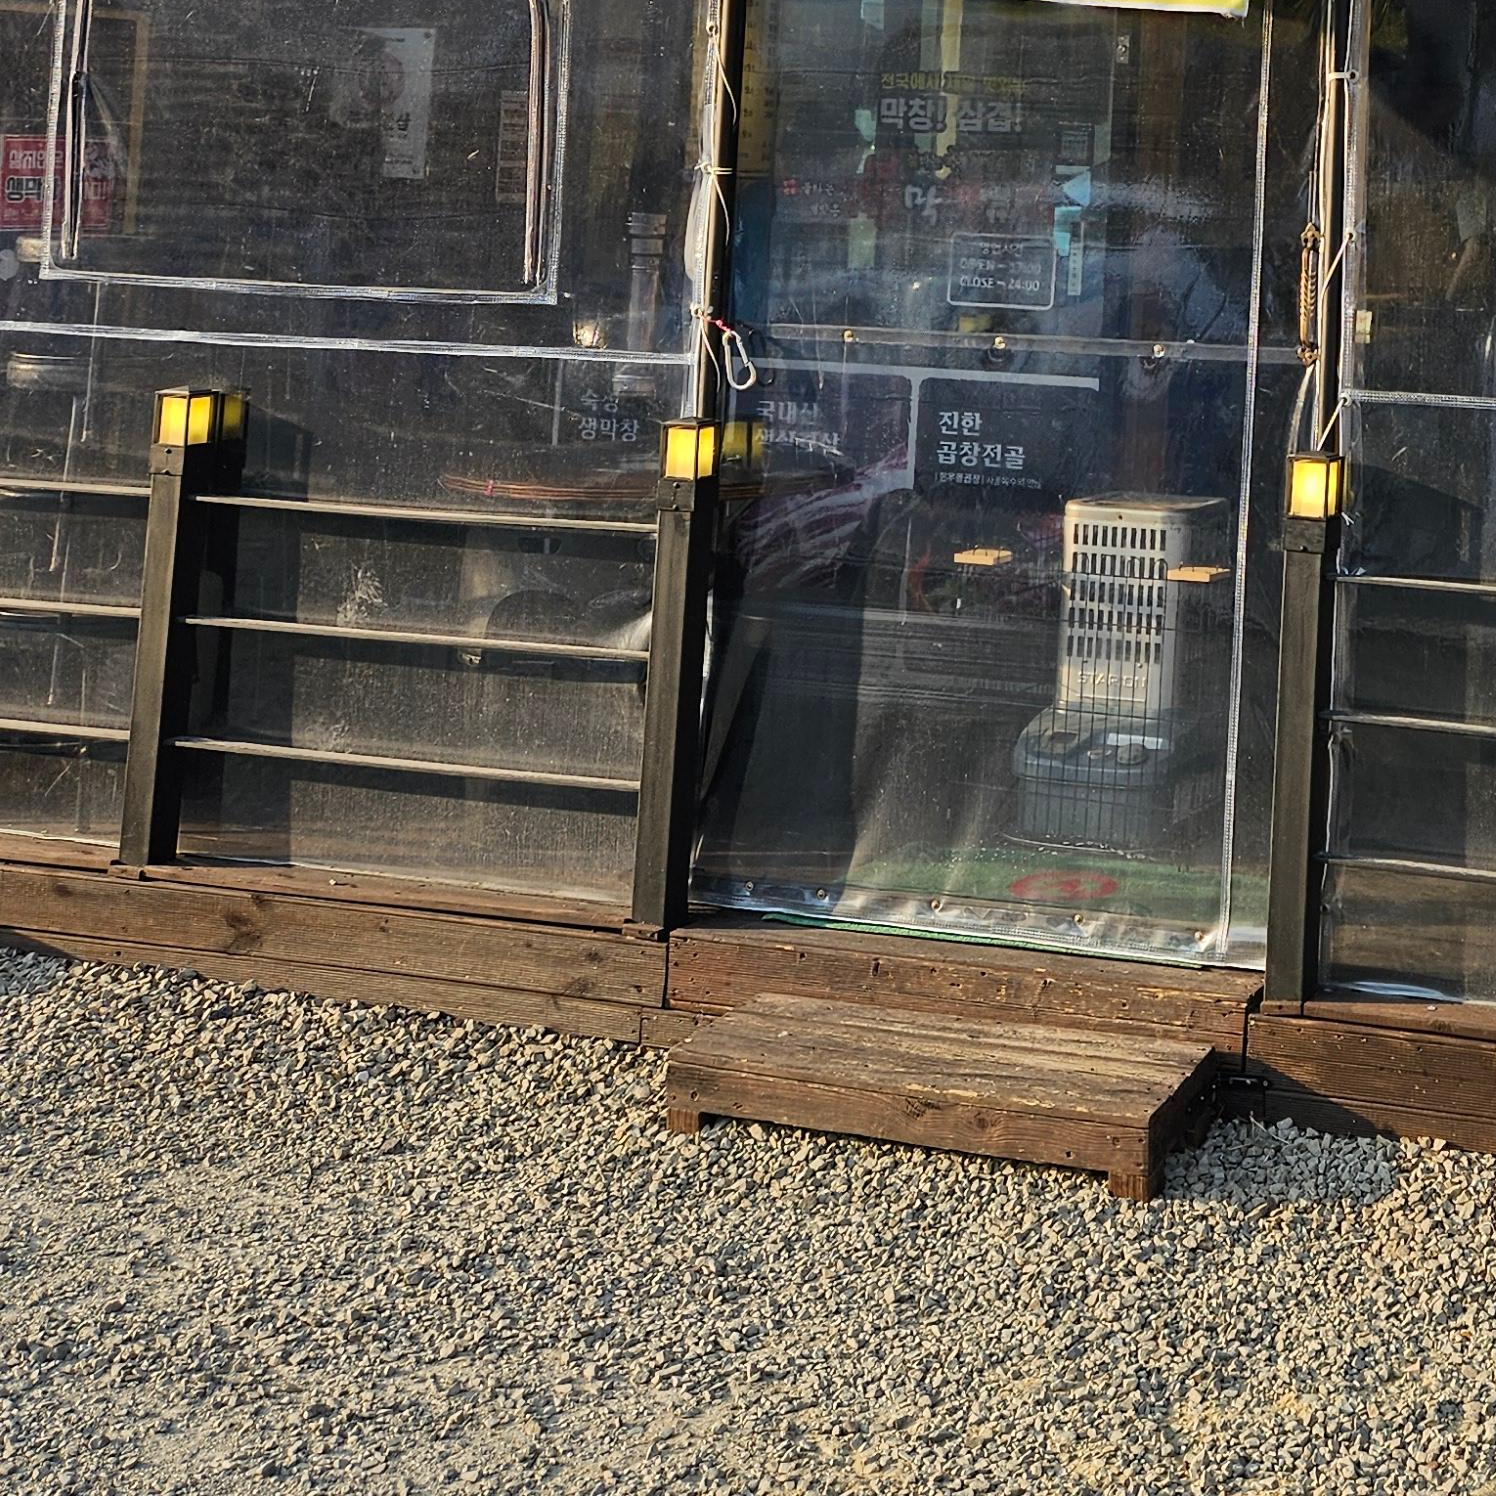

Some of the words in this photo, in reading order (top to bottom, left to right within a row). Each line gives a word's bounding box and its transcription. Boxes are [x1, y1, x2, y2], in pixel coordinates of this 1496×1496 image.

[578, 417, 640, 442] 생막창
[938, 410, 983, 436] 진한
[935, 441, 1026, 471] 곱창전골
